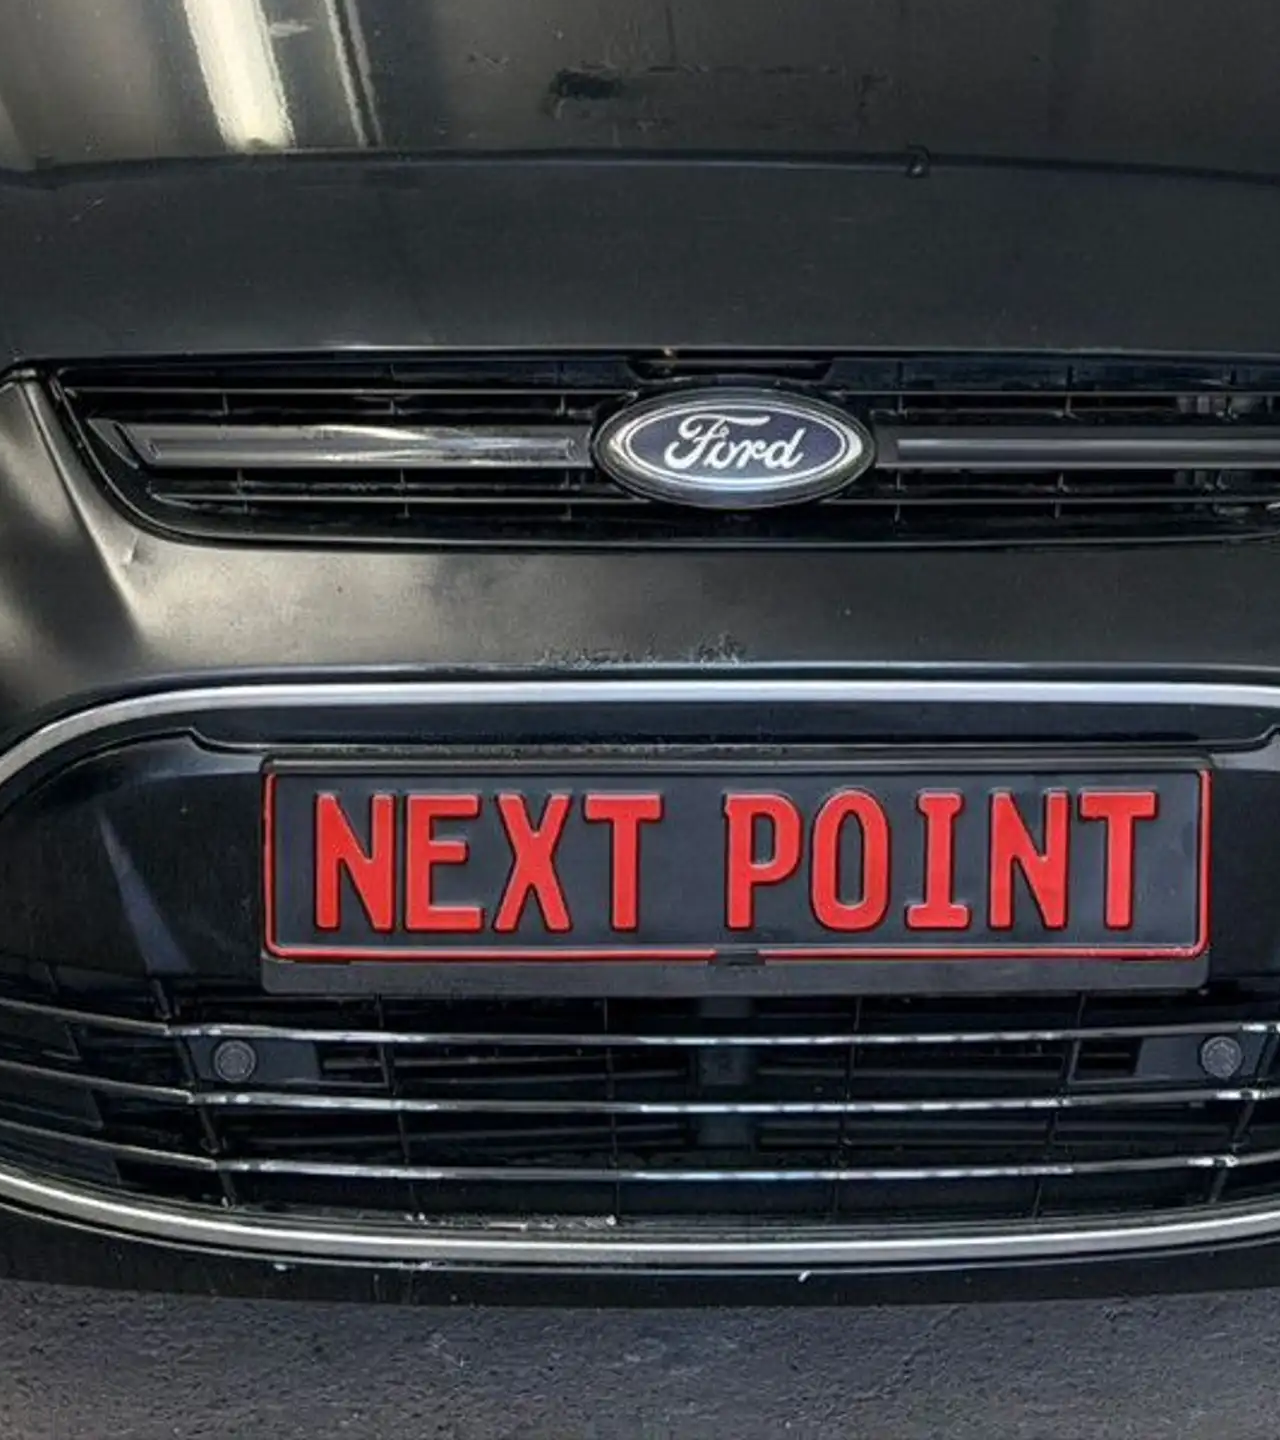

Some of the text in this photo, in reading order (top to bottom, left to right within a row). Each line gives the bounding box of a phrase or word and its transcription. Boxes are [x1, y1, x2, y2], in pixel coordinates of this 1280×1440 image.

[664, 414, 806, 469] Ford
[314, 791, 1157, 931] NEXT POINT
